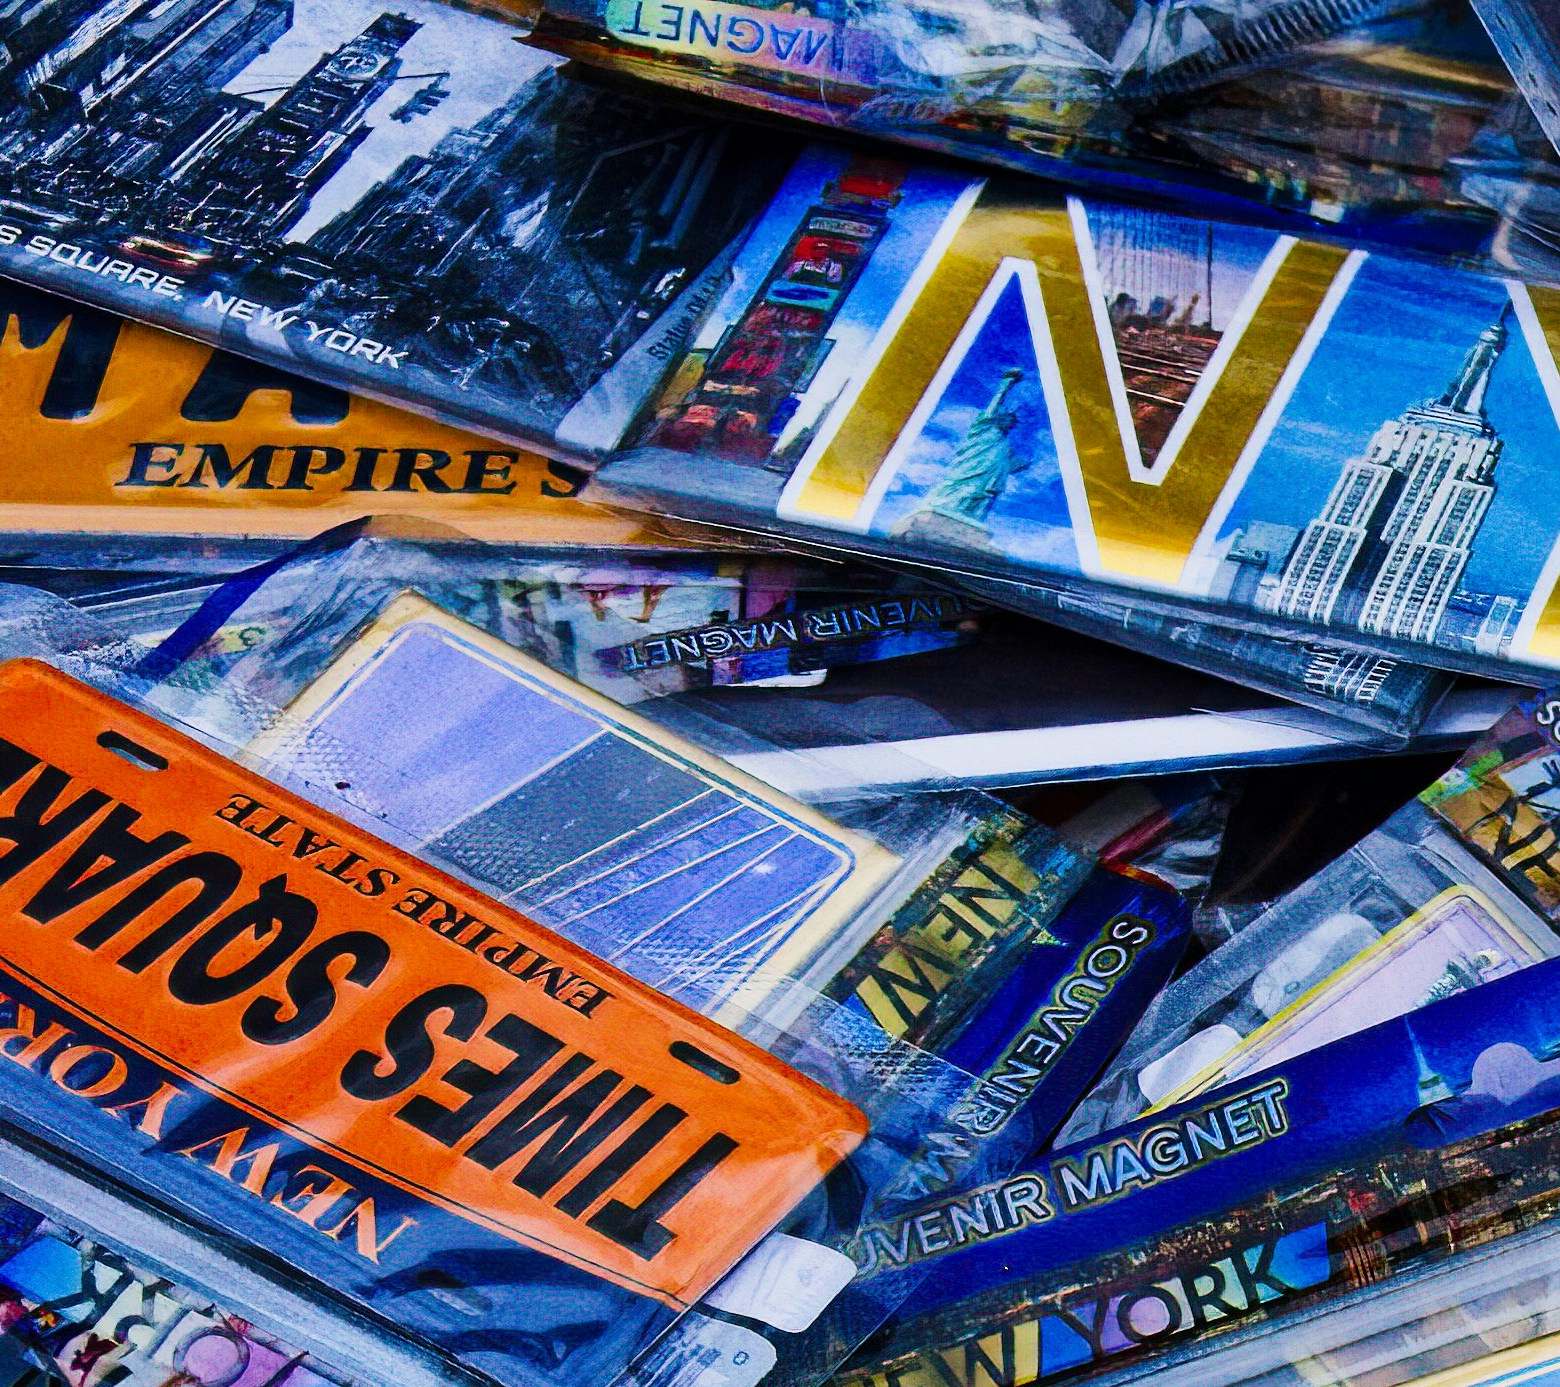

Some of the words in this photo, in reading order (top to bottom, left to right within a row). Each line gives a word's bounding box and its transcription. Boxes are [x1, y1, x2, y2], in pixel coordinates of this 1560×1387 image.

[26, 230, 183, 303] SQUARE,
[201, 290, 292, 333] NEW
[307, 321, 410, 369] YORK
[114, 441, 521, 496] EMPIRE
[620, 604, 798, 673] MAGNET
[216, 792, 384, 900] STATE
[394, 888, 617, 1020] EMPIRE
[853, 850, 1040, 1037] NEW
[948, 919, 1148, 1138] SOUVENIR
[341, 982, 720, 1263] TIMES
[1057, 1080, 1291, 1206] MAGNET
[180, 1129, 420, 1266] NEW
[1044, 1232, 1306, 1367] YORK
